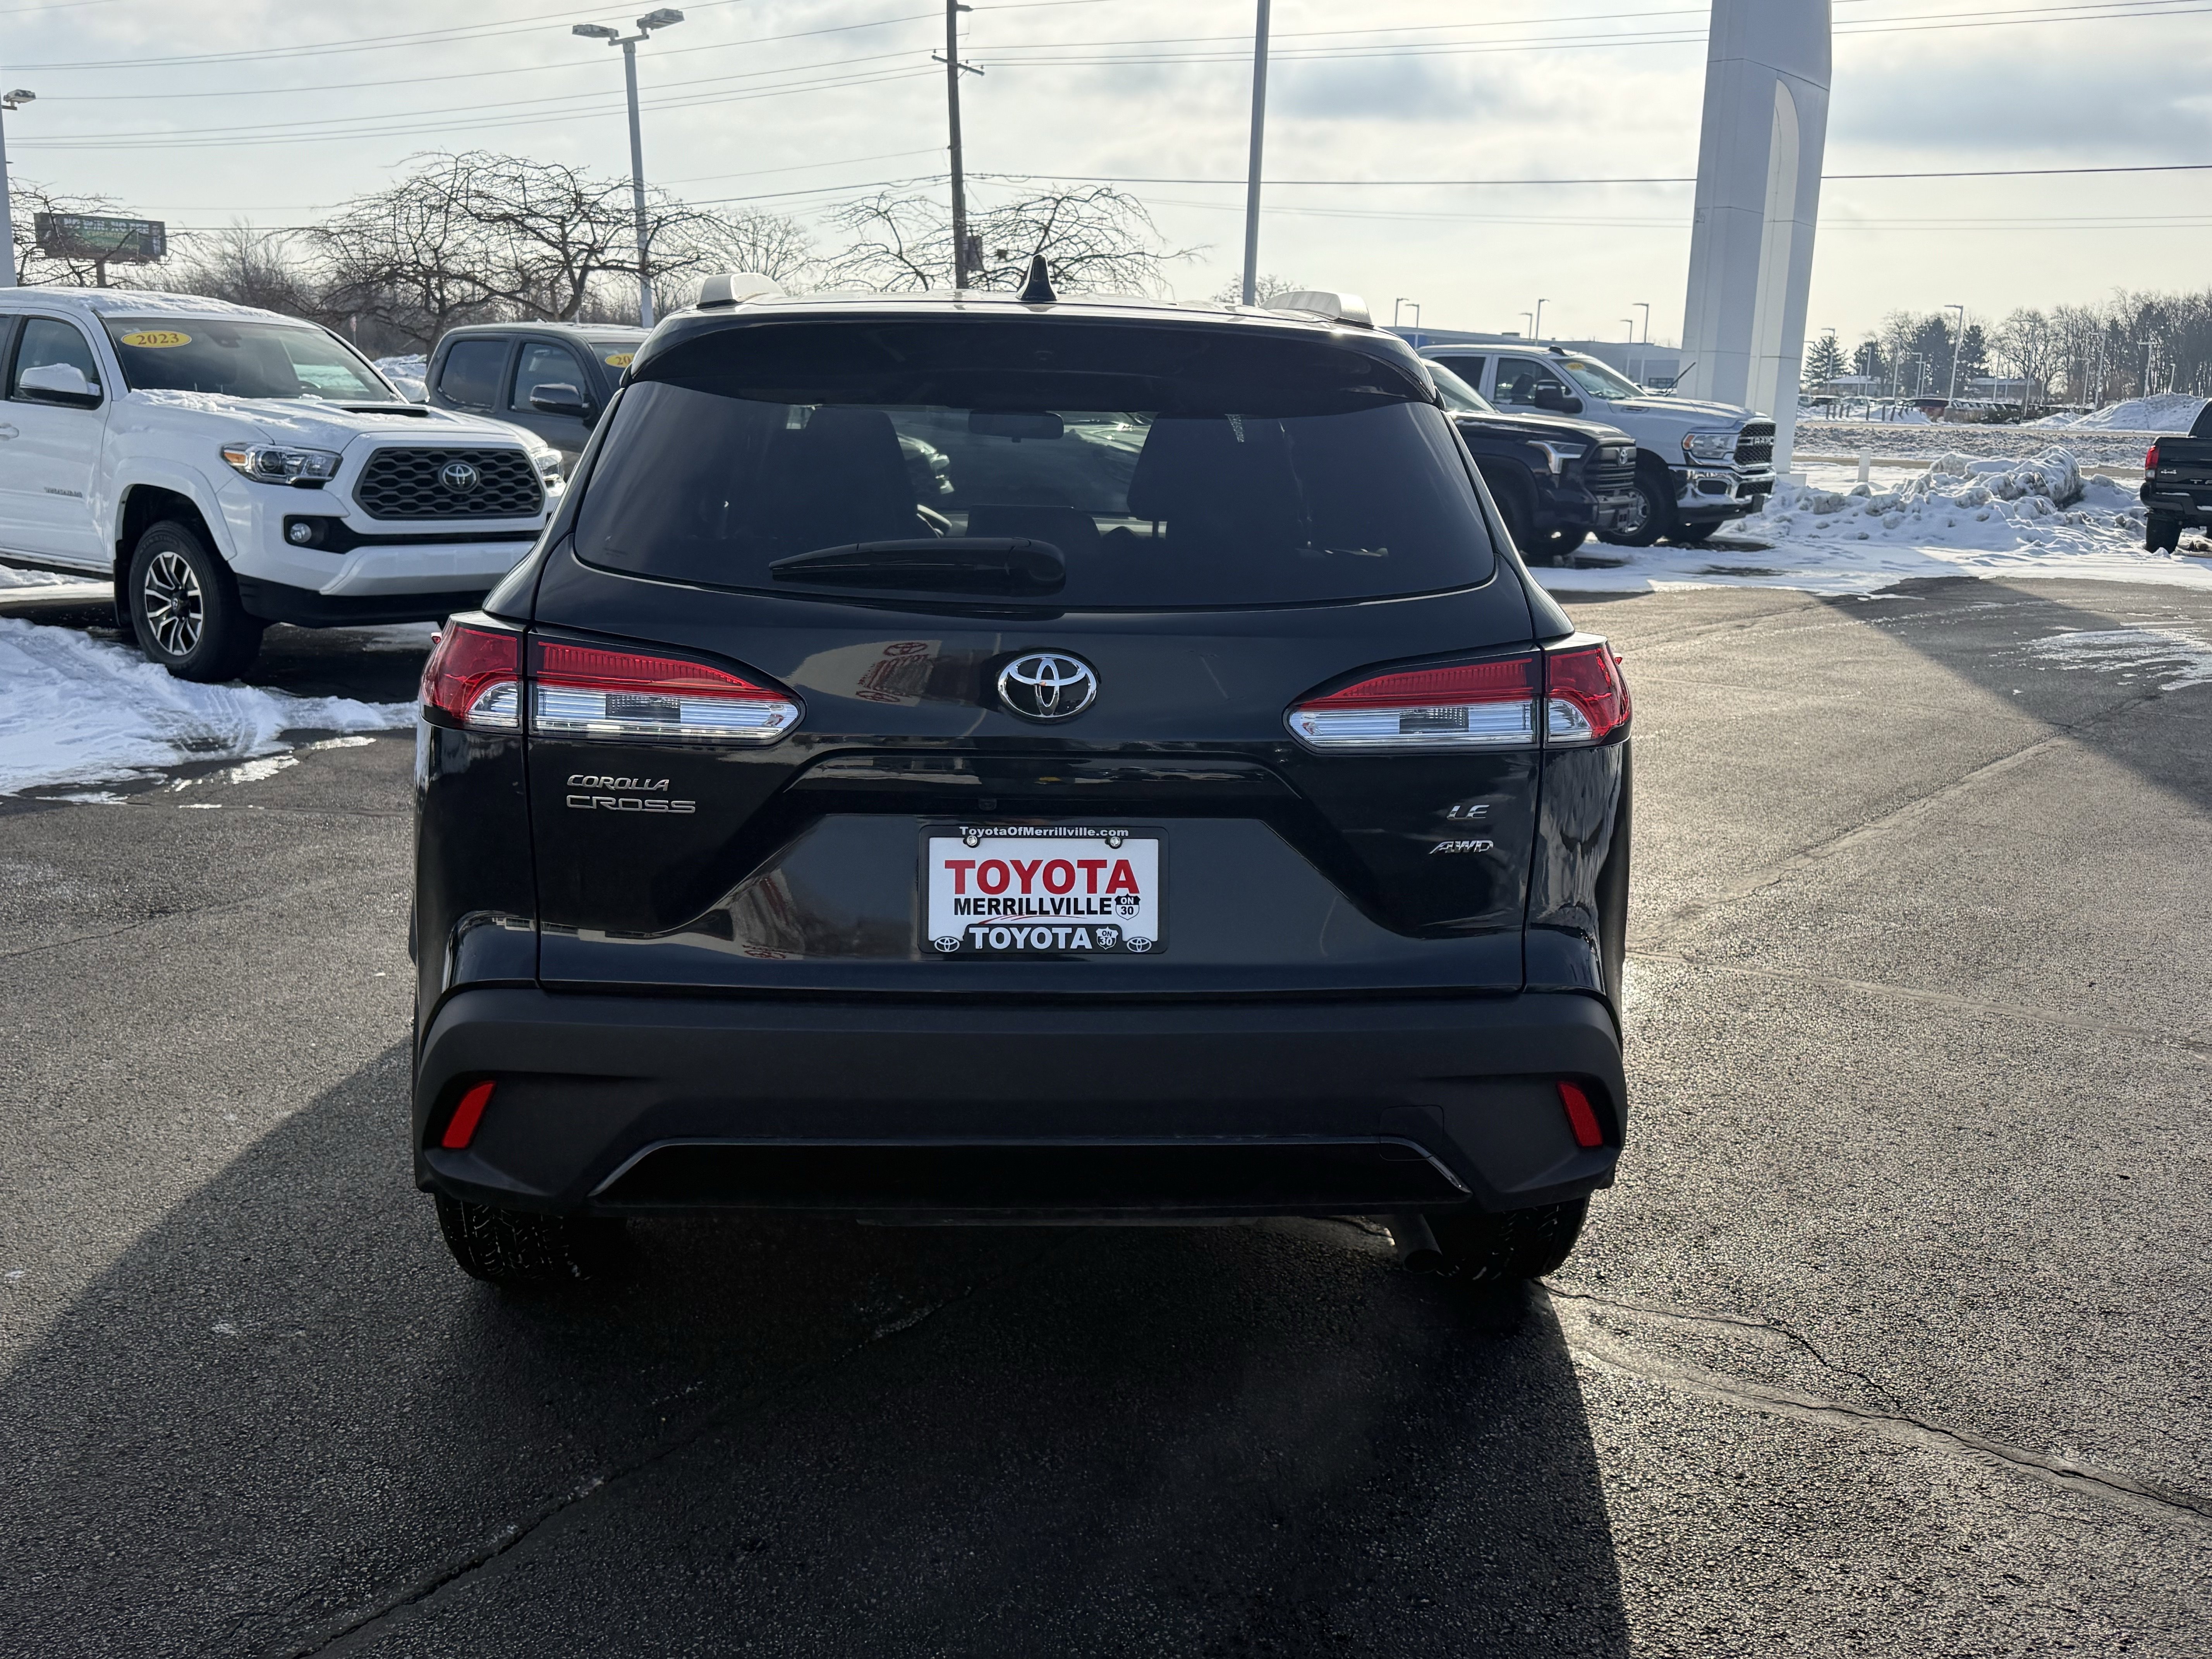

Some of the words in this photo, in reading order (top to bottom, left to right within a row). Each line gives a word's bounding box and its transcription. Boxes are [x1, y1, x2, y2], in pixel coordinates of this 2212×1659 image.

[136, 333, 179, 345] 2023
[615, 355, 633, 365] 20
[567, 775, 670, 791] COROLLA
[566, 795, 696, 814] CROSS
[1446, 804, 1490, 821] LE
[959, 826, 1128, 837] ToyotaOfMerrillville.com
[1428, 840, 1494, 855] AWD
[945, 859, 1140, 895] TOYOTA
[954, 897, 1112, 915] MERRILLVILLE
[1120, 905, 1134, 915] 30
[969, 927, 1092, 949] TOYOTA
[1099, 936, 1113, 946] 30
